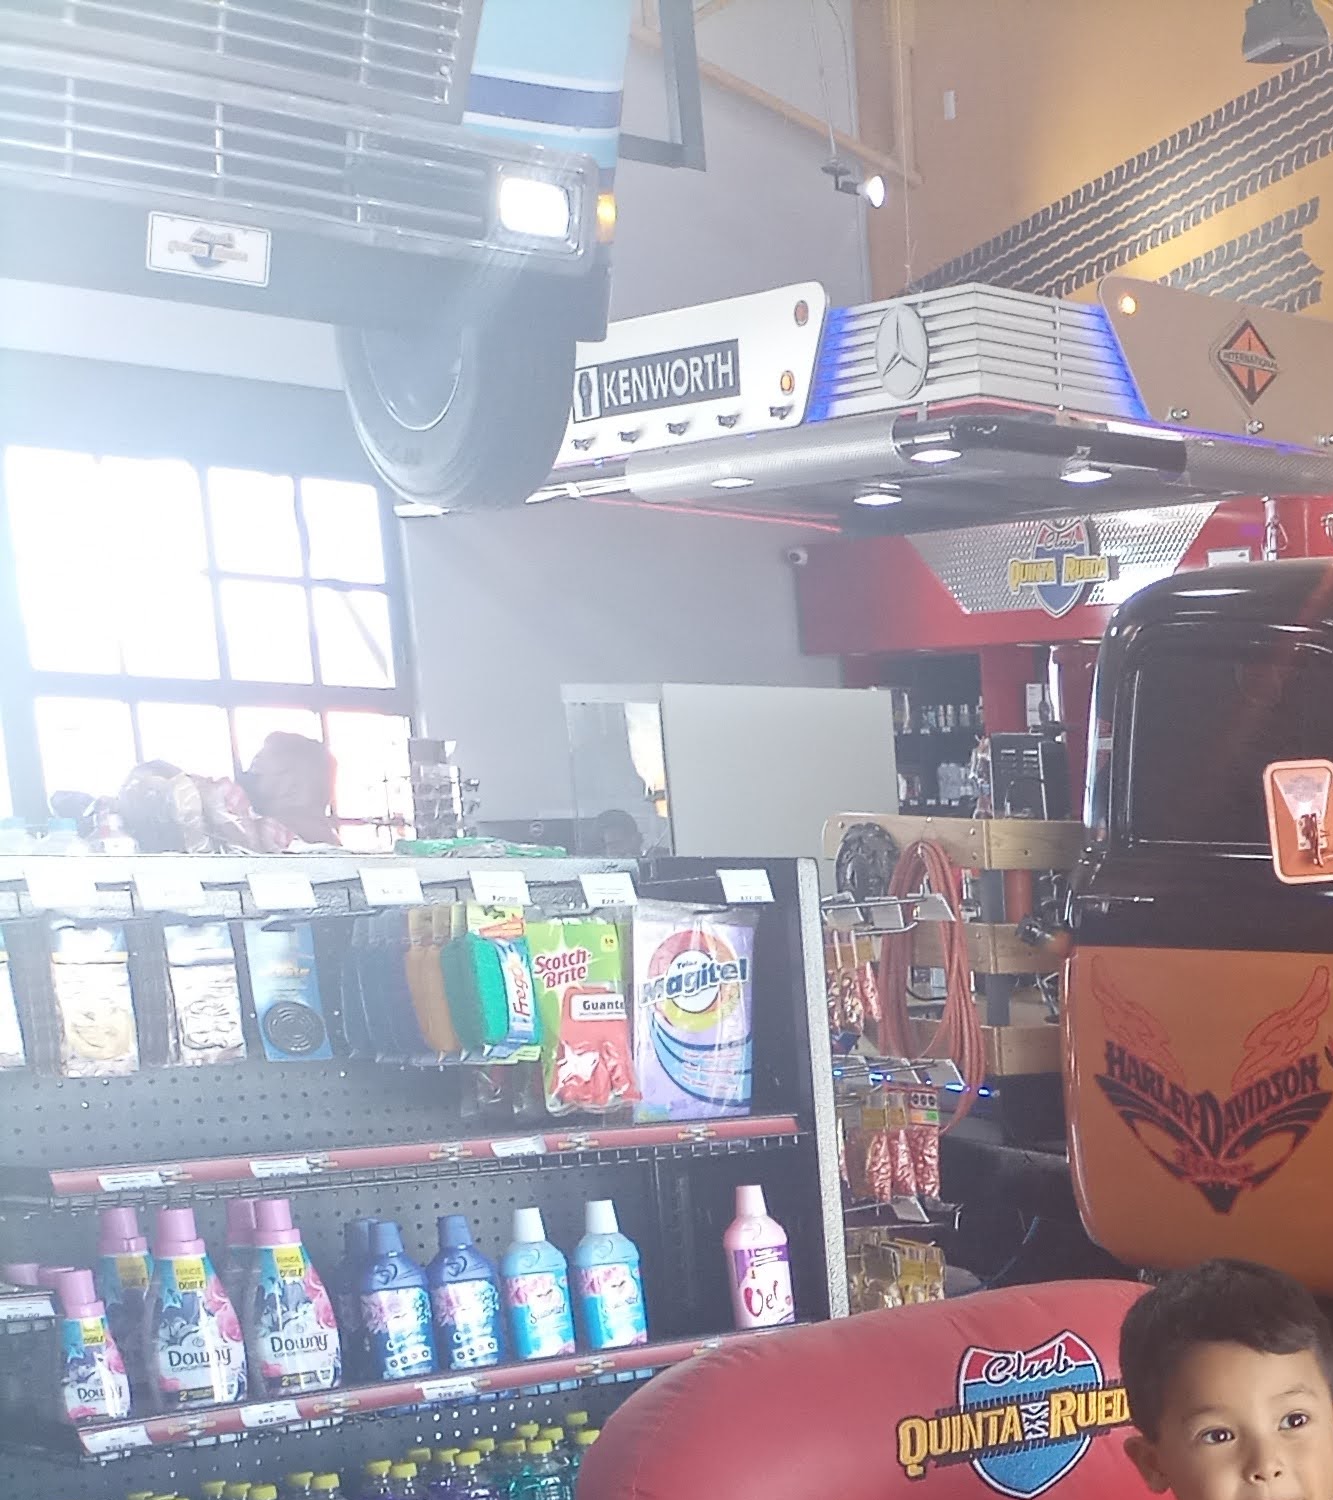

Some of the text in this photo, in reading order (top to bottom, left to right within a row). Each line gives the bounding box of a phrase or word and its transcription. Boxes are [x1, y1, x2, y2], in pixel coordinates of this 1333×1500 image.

[603, 350, 734, 408] KENWORTH
[1044, 530, 1079, 549] Club
[1010, 555, 1108, 593] QUINTA RUEDA
[533, 950, 593, 977] Scotch-
[545, 966, 587, 990] Brite
[640, 958, 749, 1005] Magitel
[746, 1283, 780, 1318] Vel
[168, 1346, 233, 1369] Downy
[269, 1333, 329, 1354] Downy
[981, 1342, 1076, 1386] Club
[898, 1387, 1132, 1478] QUINTA RUED
